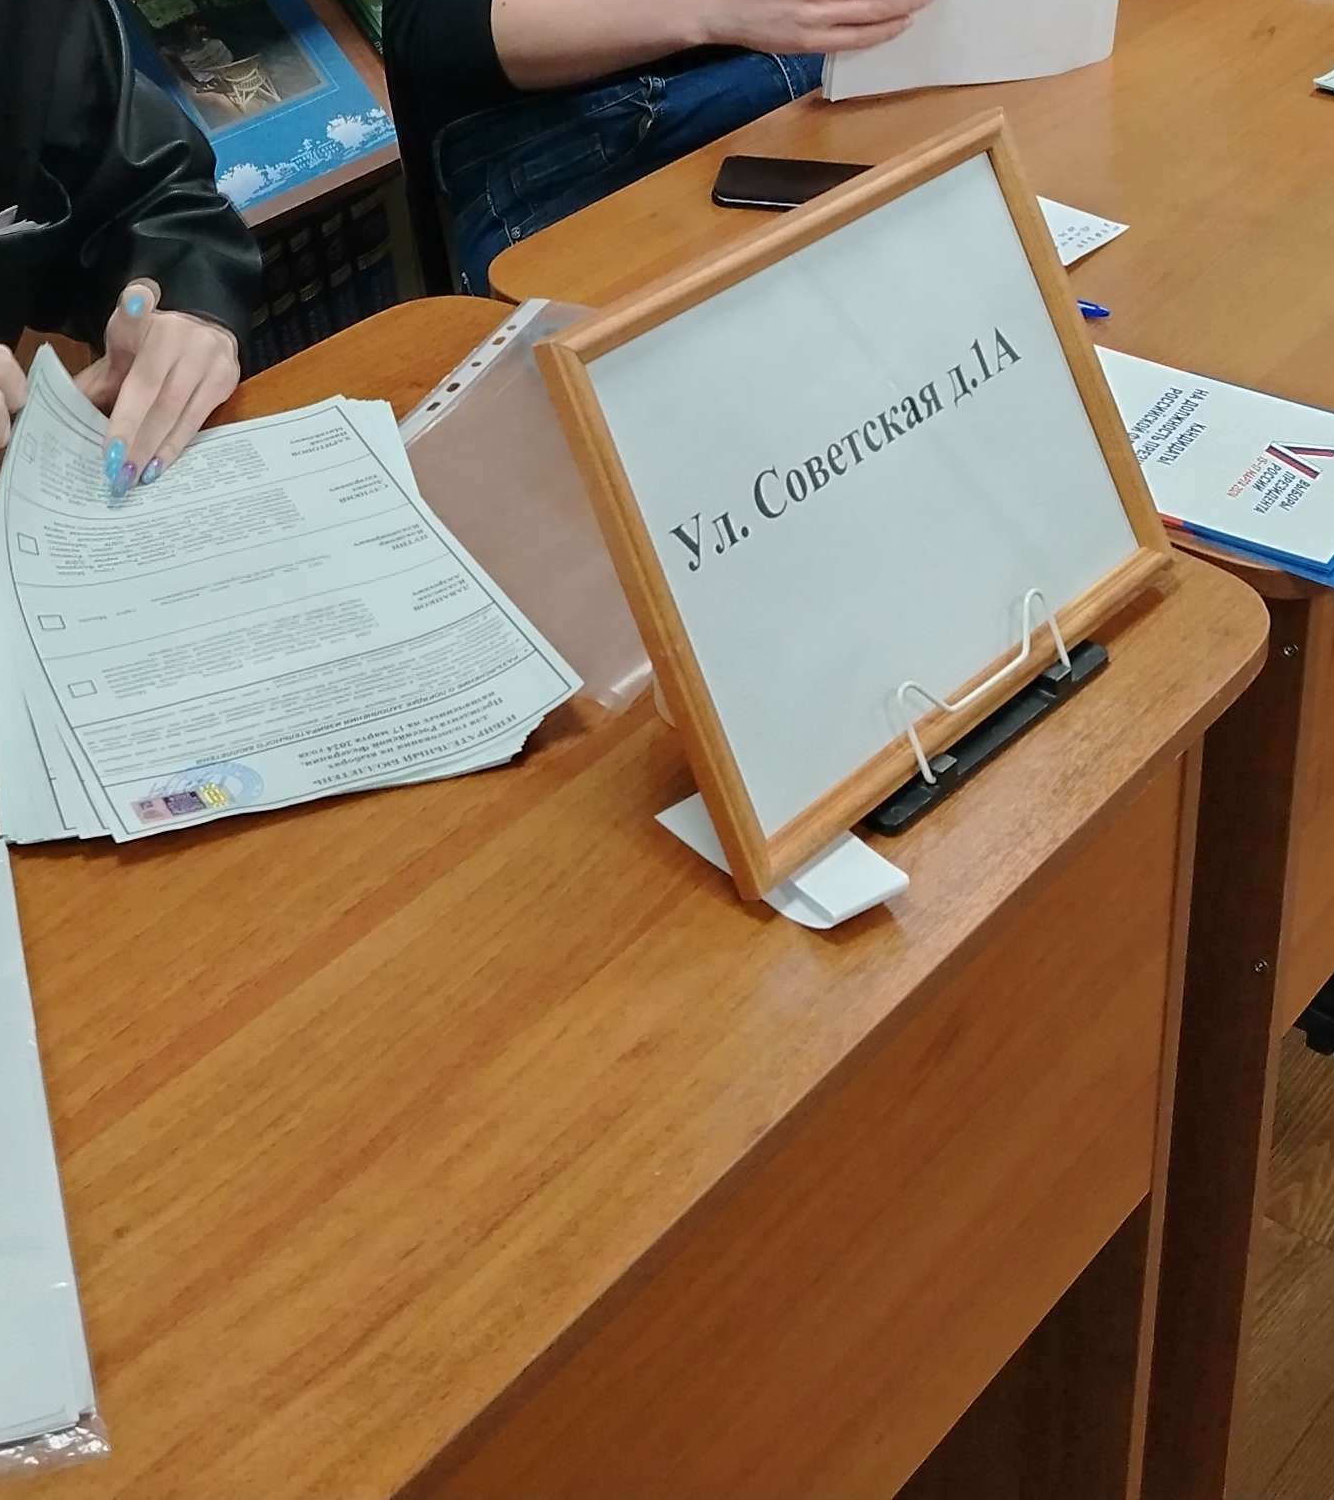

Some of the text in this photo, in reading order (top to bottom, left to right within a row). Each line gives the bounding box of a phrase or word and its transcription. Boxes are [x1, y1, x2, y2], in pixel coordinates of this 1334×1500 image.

[1132, 387, 1183, 434] РОССИЙСКОЙ
[1194, 388, 1209, 408] НА
[1152, 397, 1198, 441] ДОЛЖНОСТЬ
[669, 326, 1023, 572] Ул. Советская д.1А
[1158, 422, 1206, 465] КАНДИДАТЫ
[1253, 463, 1281, 492] РОССИИ
[1254, 470, 1297, 514] ПРЕЗИДЕНТА
[1279, 479, 1309, 511] ВЫБОРЫ
[439, 696, 503, 729] Президента
[327, 738, 352, 753] 2024
[354, 728, 390, 744] марта
[372, 723, 437, 749] Российской
[392, 725, 404, 737] 17
[312, 714, 516, 785] ИЗБИРАТЕЛЬНЫЙ БЮЛЛЕТЕНЬ
